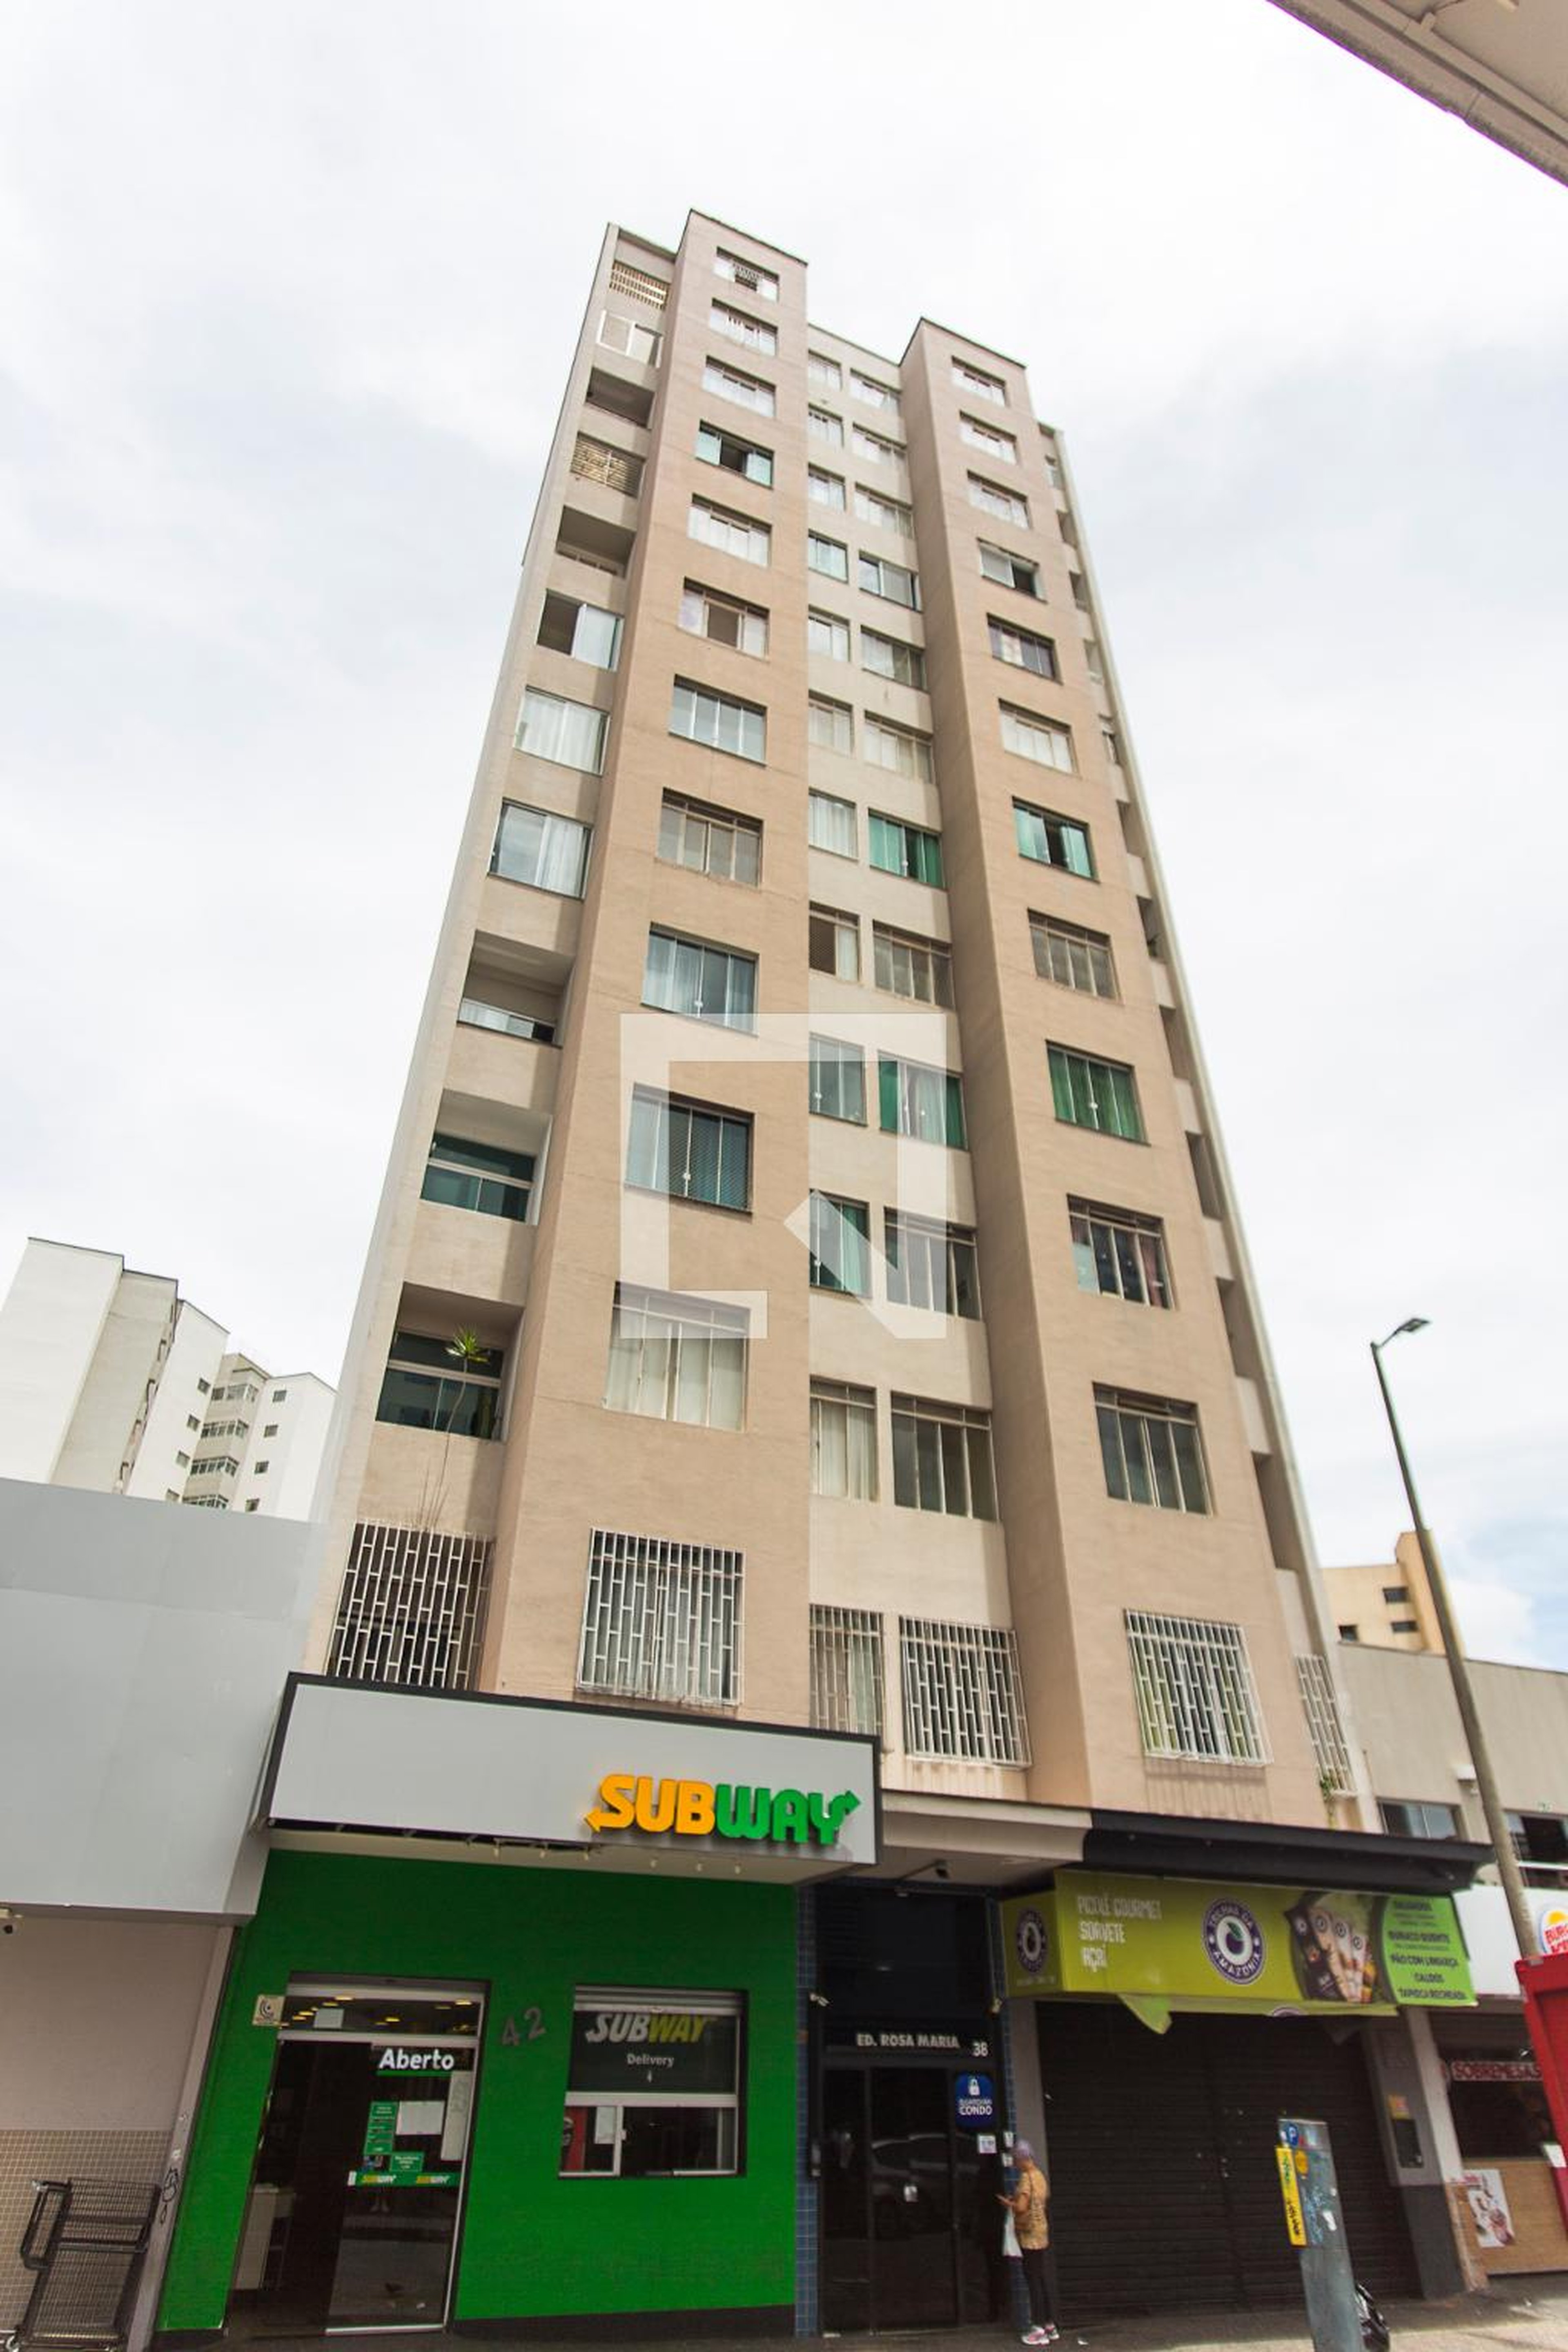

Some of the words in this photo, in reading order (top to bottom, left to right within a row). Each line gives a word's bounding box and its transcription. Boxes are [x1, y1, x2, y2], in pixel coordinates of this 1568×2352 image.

[585, 1774, 860, 1844] SUBWAY
[1080, 1920, 1126, 1943] SORVETE
[586, 2013, 713, 2042] SUBWAY
[880, 2033, 915, 2047] ROSA
[918, 2034, 960, 2048] MARIA
[973, 2041, 988, 2057] 38
[379, 2047, 454, 2070] Aberto
[626, 2053, 674, 2067] Delivery
[959, 2105, 993, 2116] CONDO
